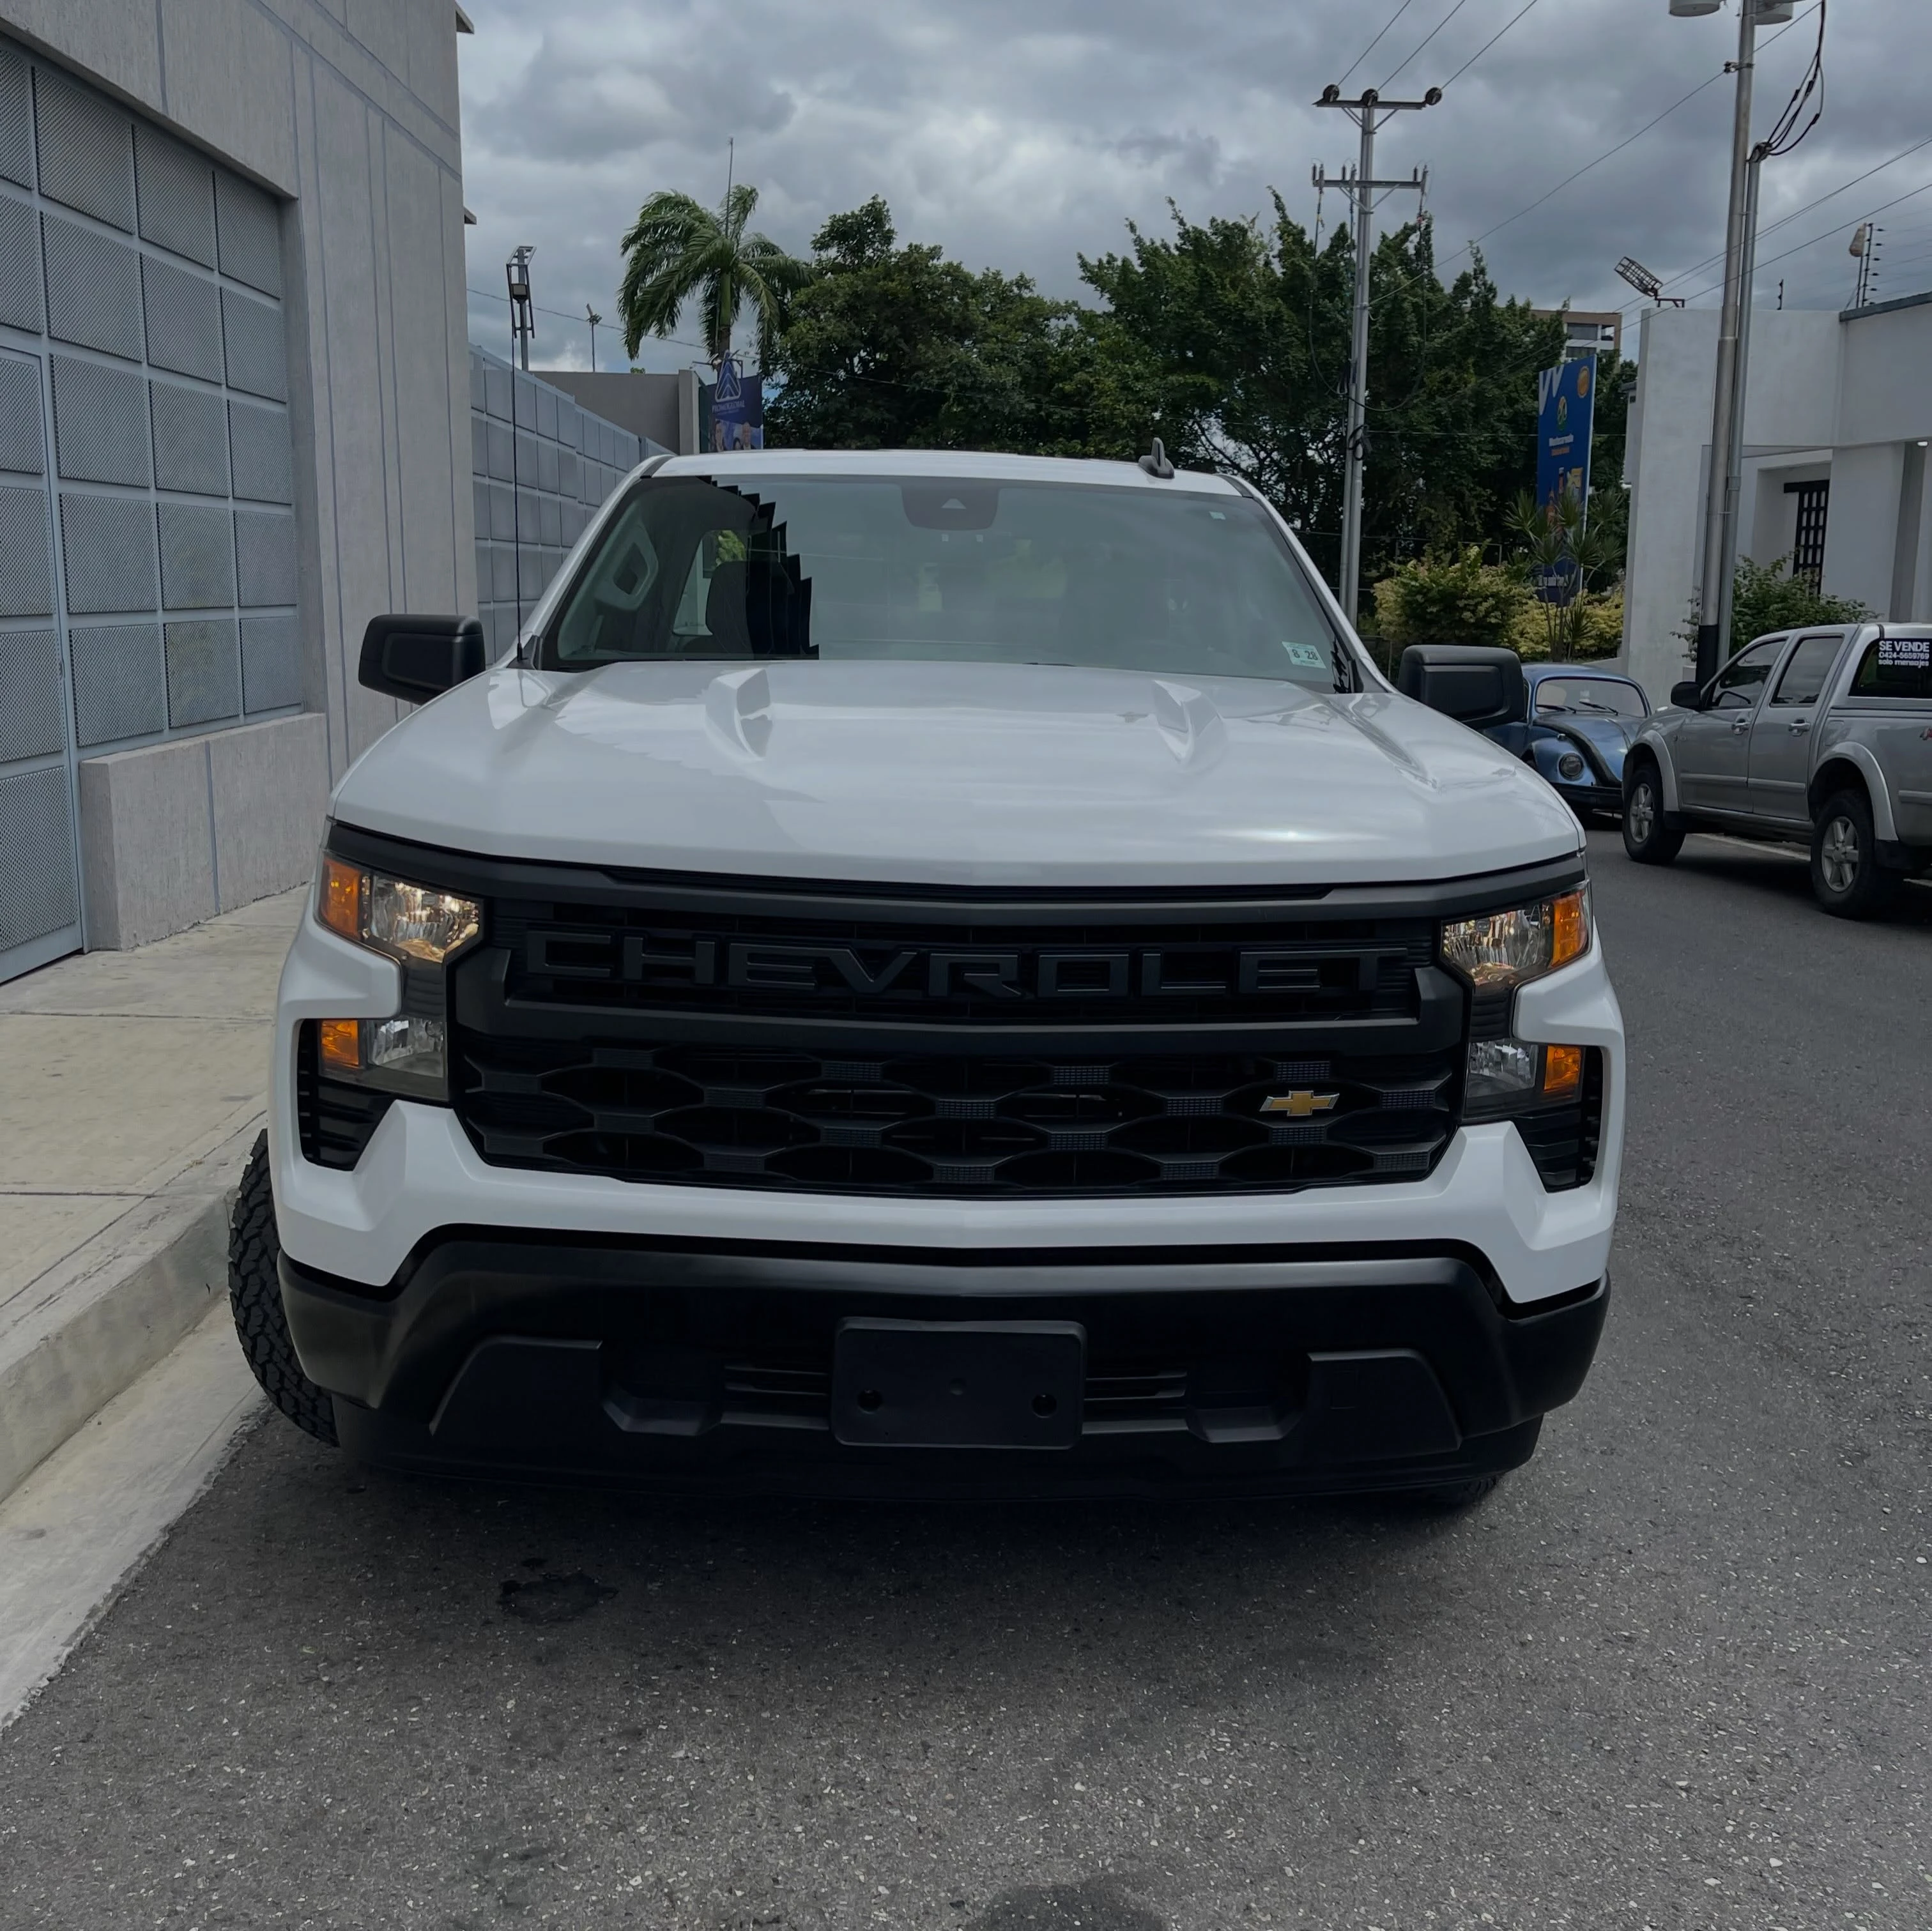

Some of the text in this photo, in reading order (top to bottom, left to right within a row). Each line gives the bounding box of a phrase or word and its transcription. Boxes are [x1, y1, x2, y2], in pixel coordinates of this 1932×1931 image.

[1879, 641, 1929, 652] SE VENDE
[1894, 659, 1929, 668] mensajes
[526, 929, 1409, 998] CHEVROLET
